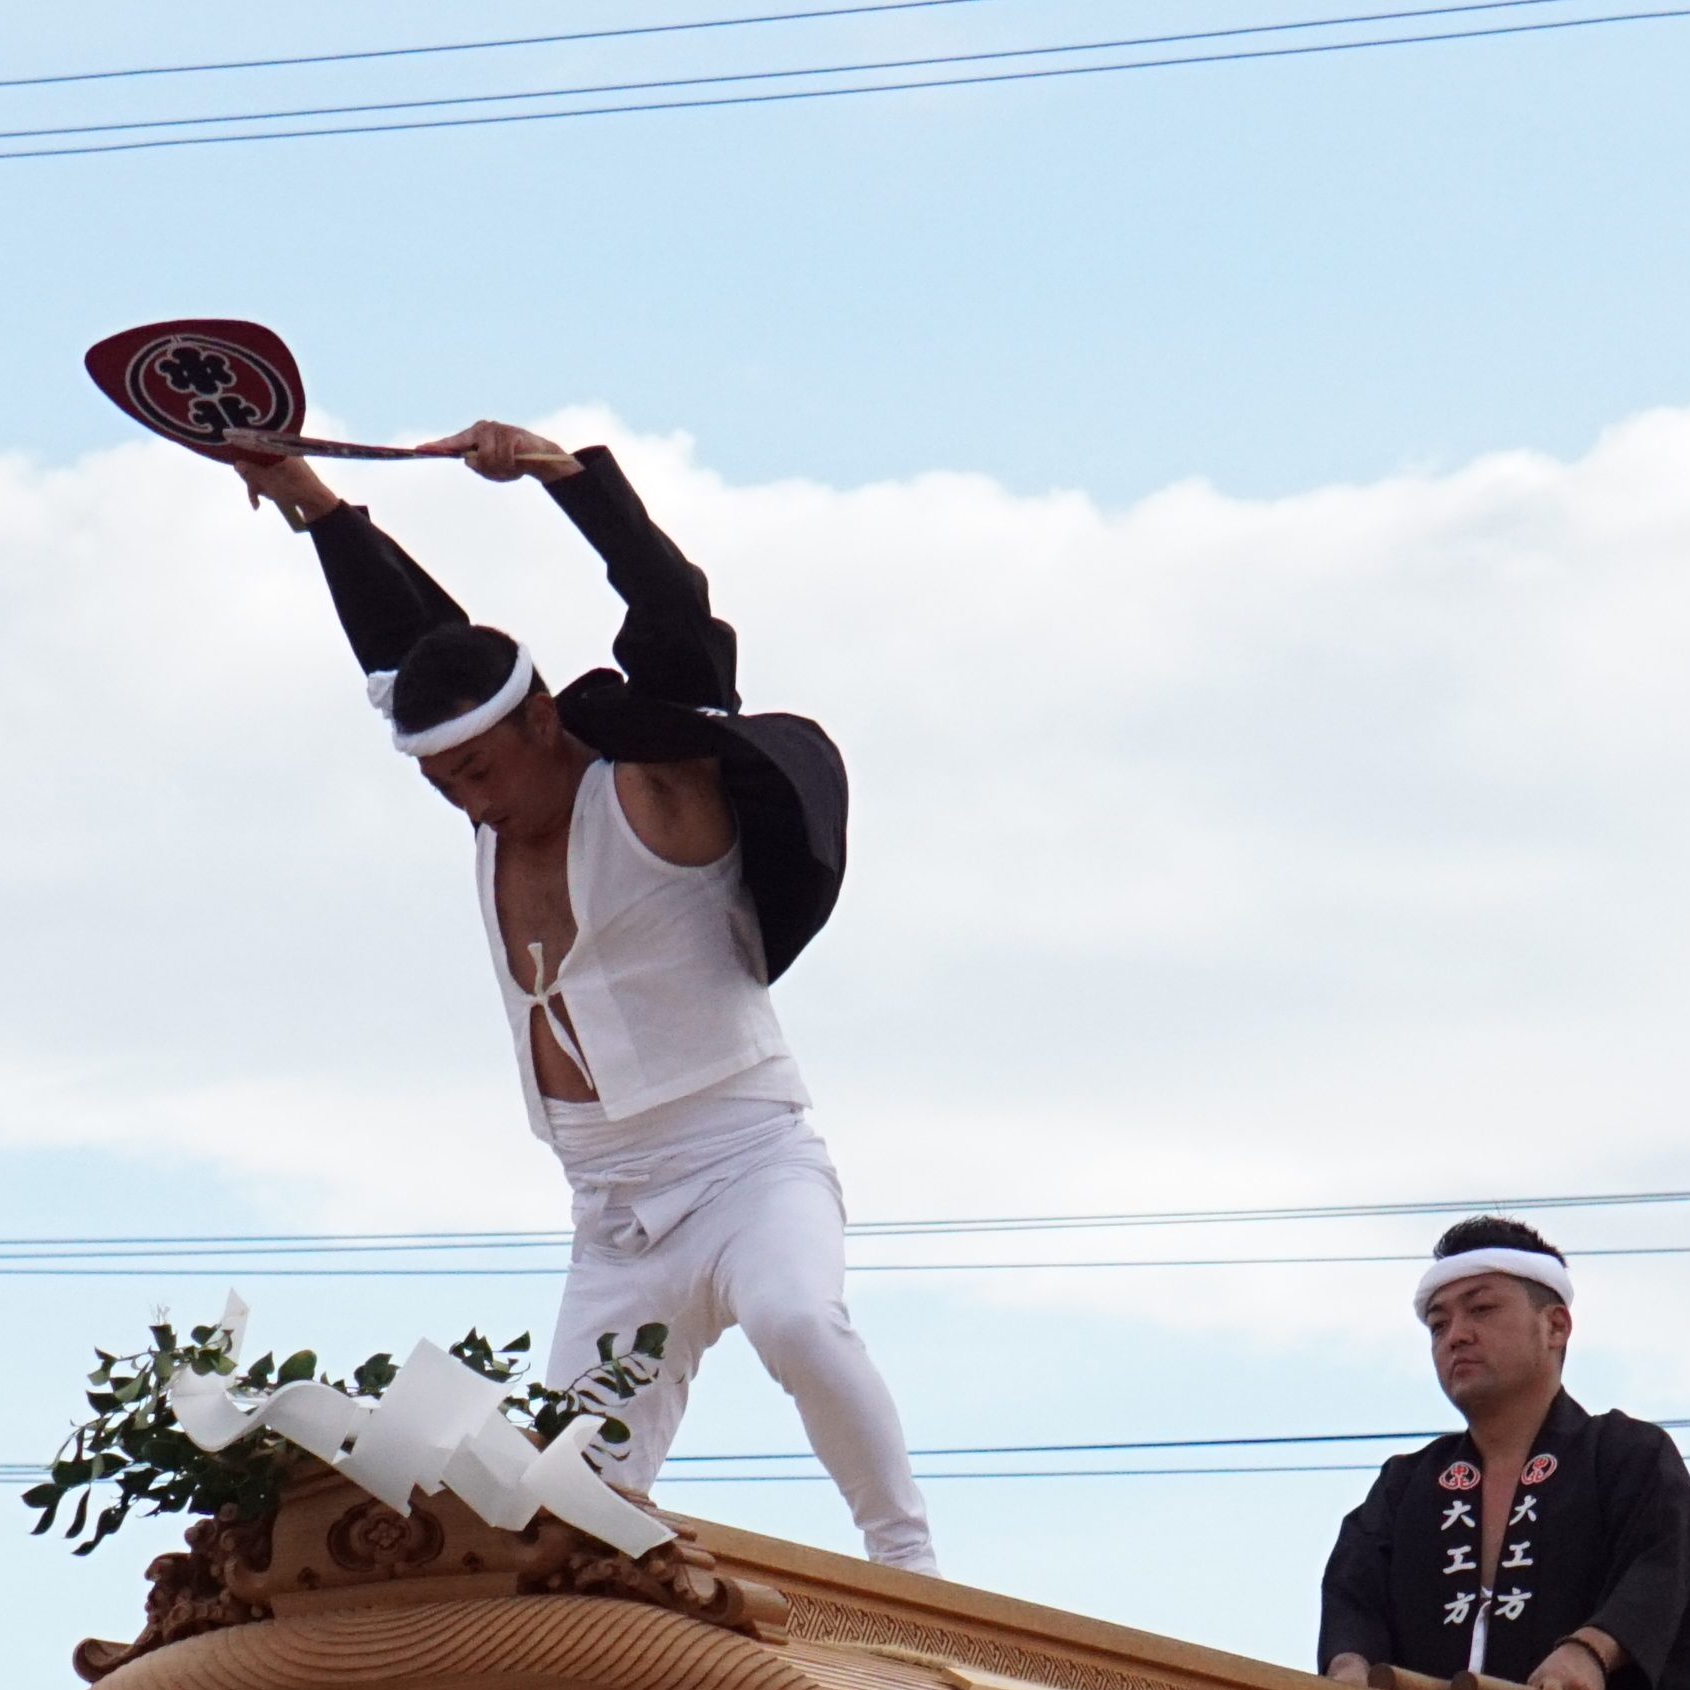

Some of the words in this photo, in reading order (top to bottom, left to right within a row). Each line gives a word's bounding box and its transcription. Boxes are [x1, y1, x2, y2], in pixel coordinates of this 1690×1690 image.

[1441, 1500, 1477, 1626] 大工方
[1494, 1494, 1538, 1622] 大工方
